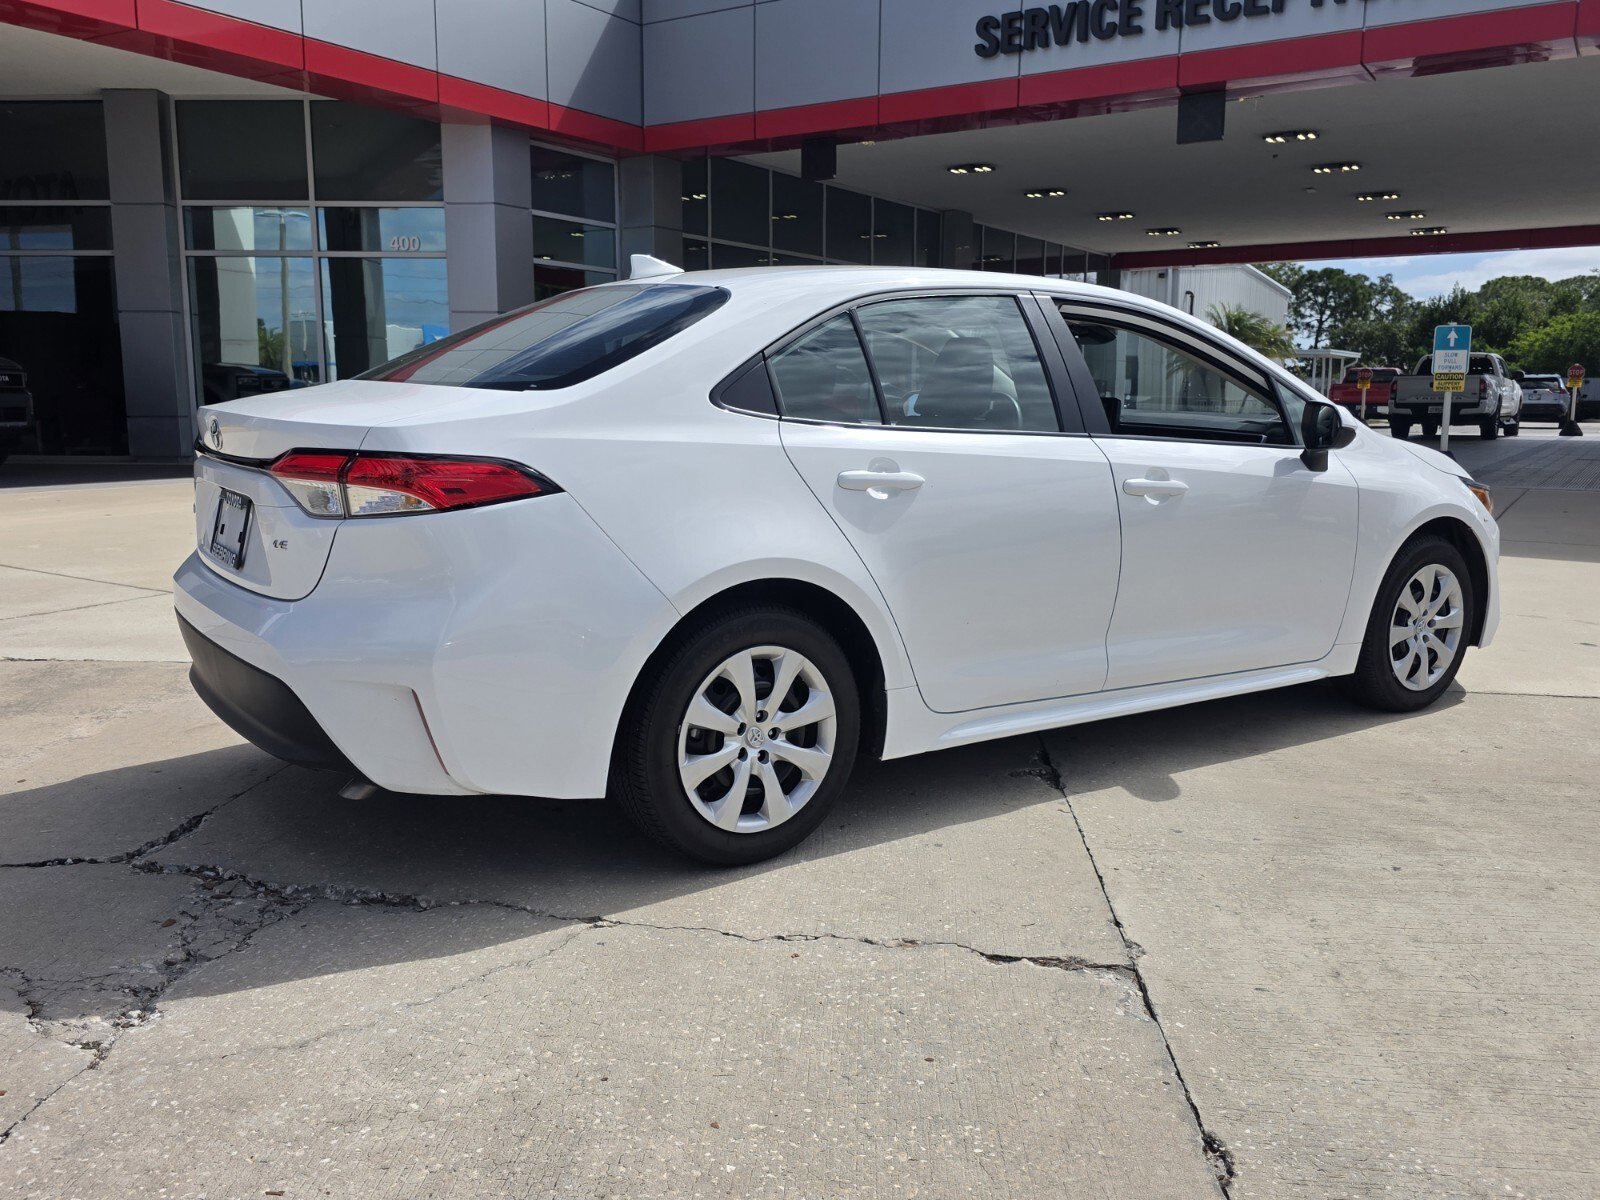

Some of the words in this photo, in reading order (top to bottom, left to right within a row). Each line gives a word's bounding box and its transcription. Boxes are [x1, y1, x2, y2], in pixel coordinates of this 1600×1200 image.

[974, 0, 1143, 58] SERVICE
[390, 236, 421, 251] 400
[273, 539, 288, 549] LE
[211, 542, 236, 567] SEBRING
